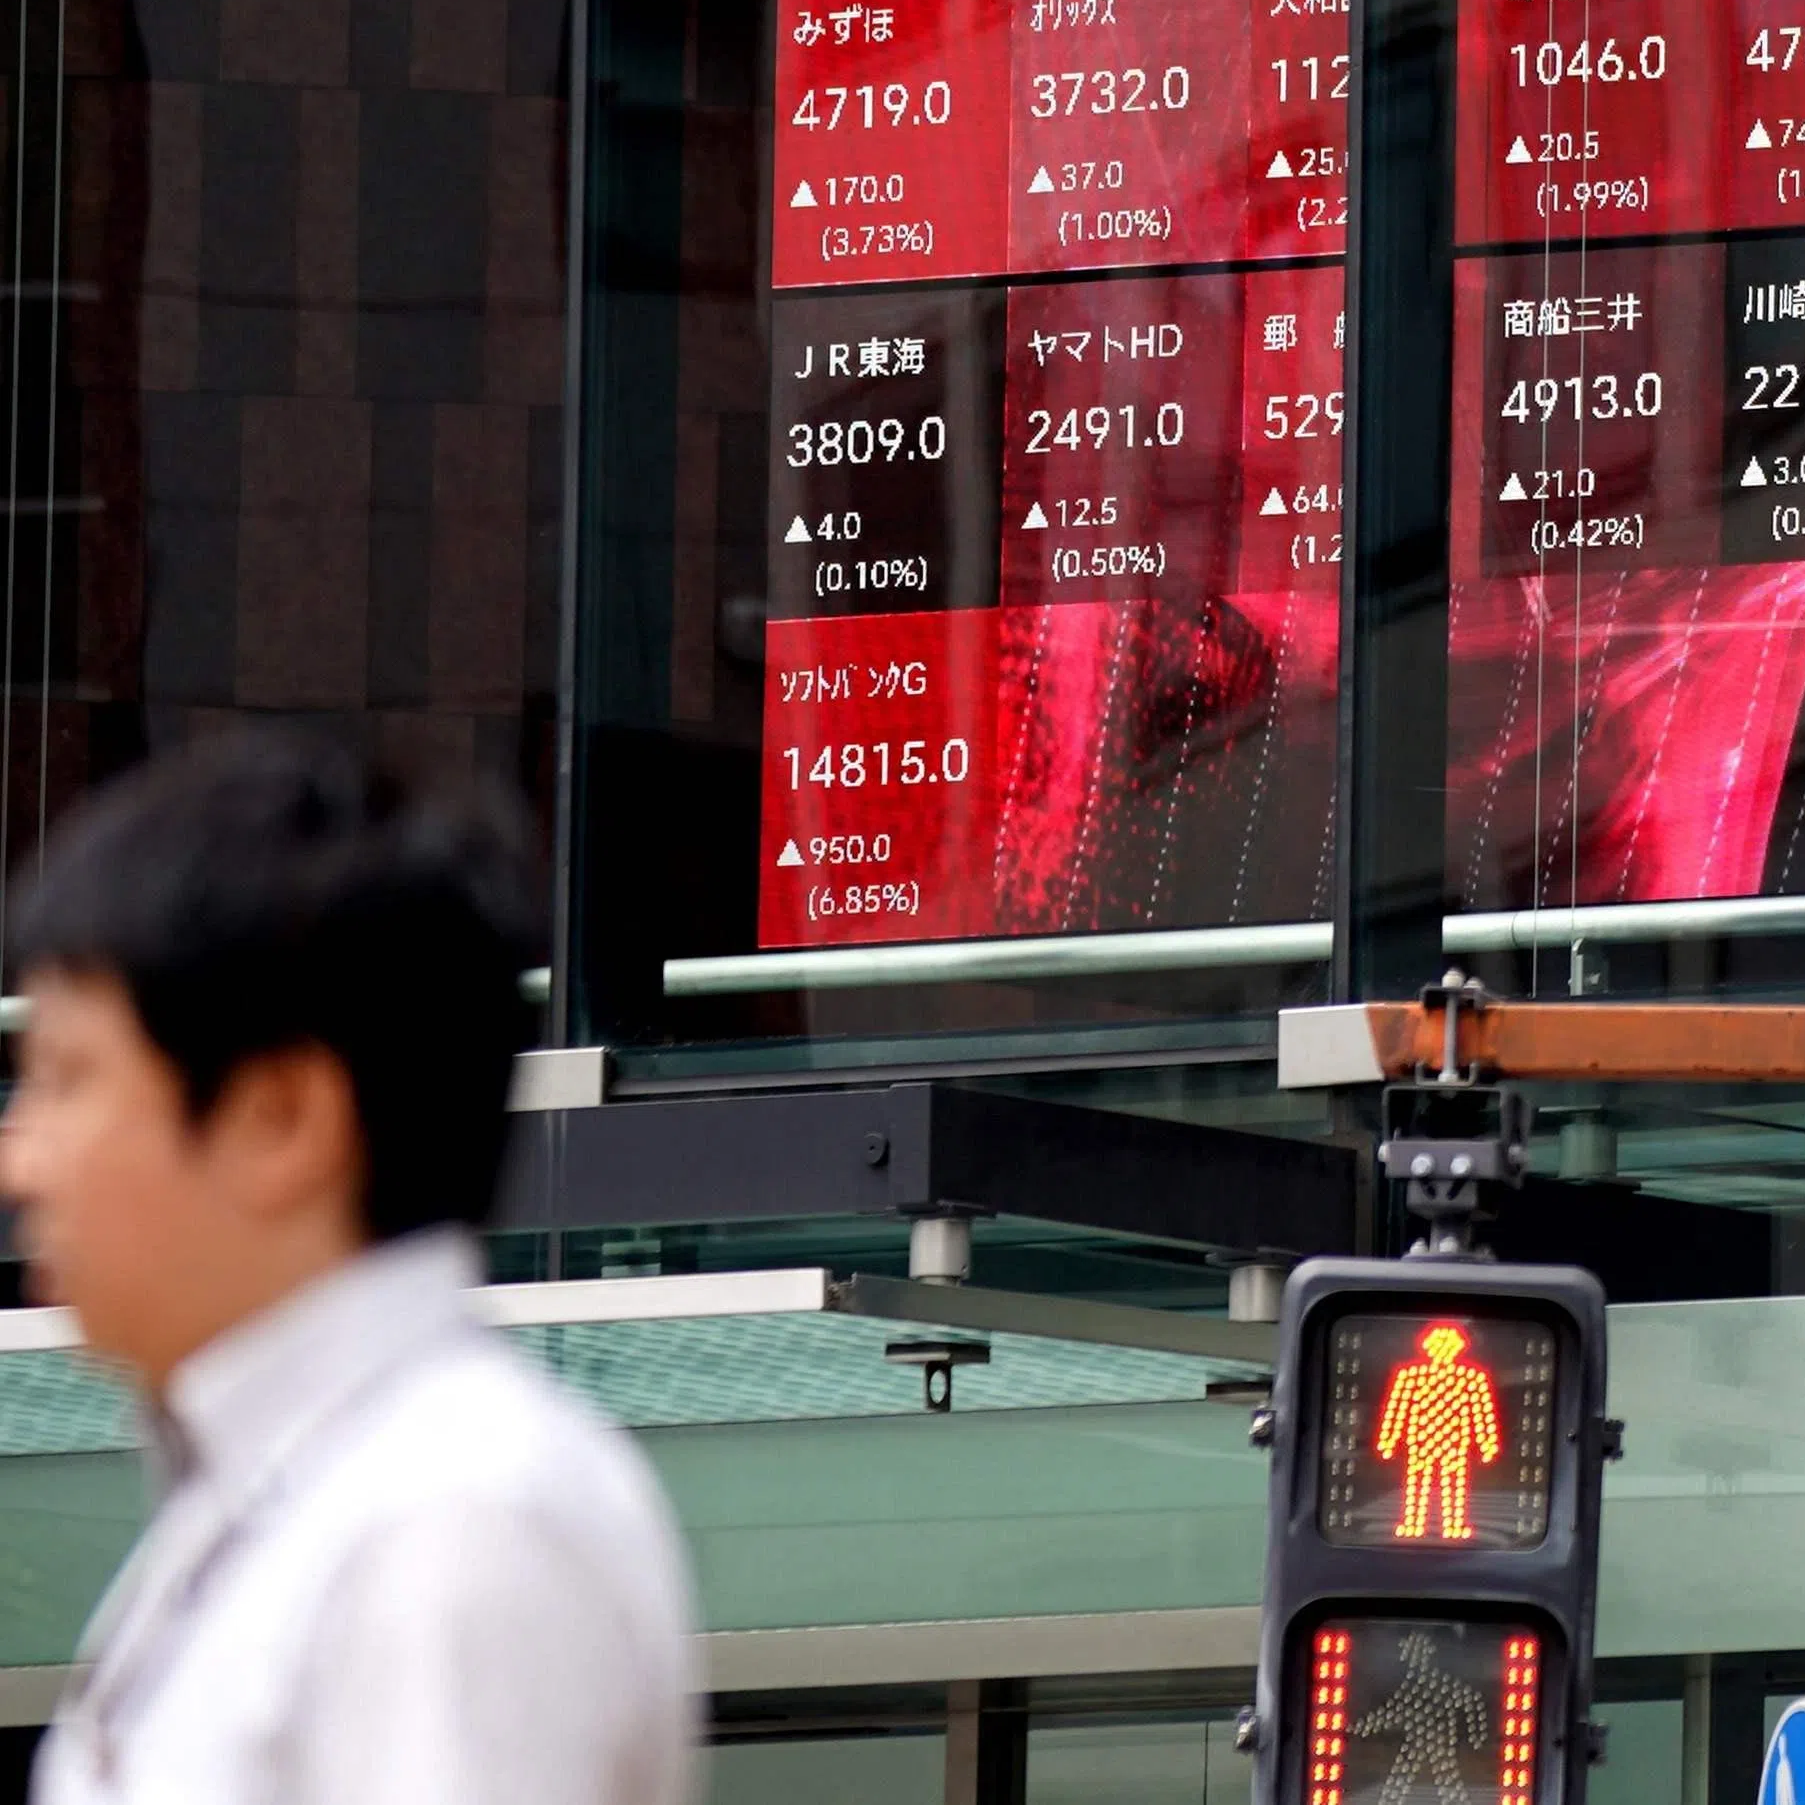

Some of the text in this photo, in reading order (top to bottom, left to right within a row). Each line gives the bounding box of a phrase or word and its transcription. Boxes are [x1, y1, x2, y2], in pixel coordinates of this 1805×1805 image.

[794, 4, 893, 45] みずほ
[1511, 33, 1665, 86] 1046.0
[1031, 66, 1188, 117] 3732.0
[1538, 132, 1598, 161] 20.5
[1062, 161, 1122, 190] 37.0
[1504, 293, 1642, 337] 商船三井
[1028, 325, 1182, 366] ヤマトHD
[1502, 373, 1661, 423] 4913.0
[787, 417, 944, 467] 3809.0
[1533, 468, 1594, 499] 21.0
[816, 556, 926, 596] (0.10%)
[1052, 543, 1165, 582] (0.50%)
[784, 739, 968, 789] 14815.0
